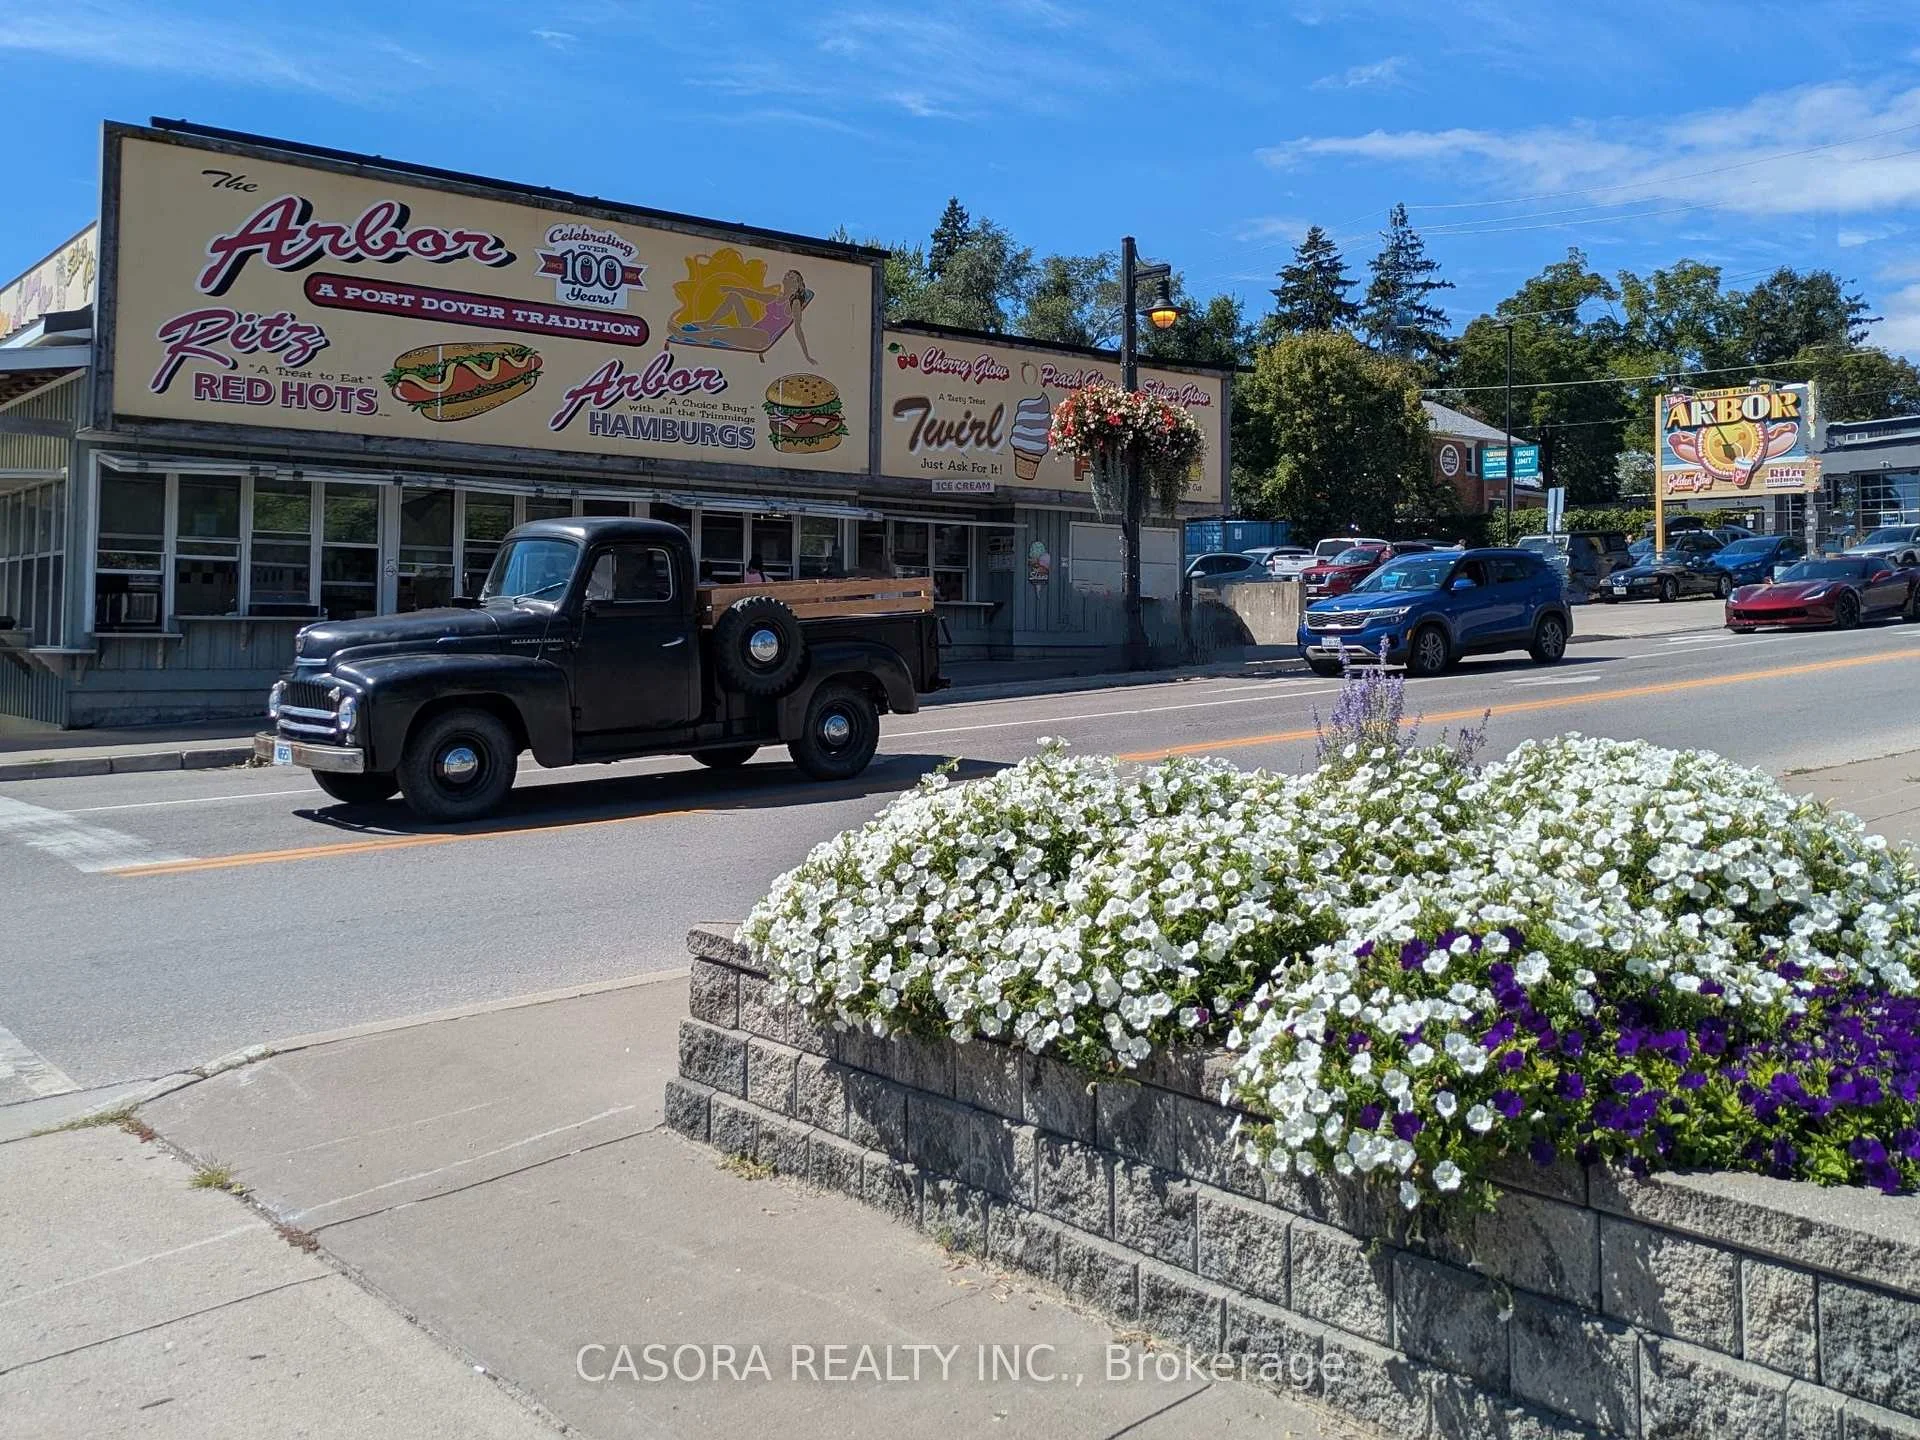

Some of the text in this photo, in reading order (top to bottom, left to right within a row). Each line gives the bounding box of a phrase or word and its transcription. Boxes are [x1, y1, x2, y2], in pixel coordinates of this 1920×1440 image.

[201, 169, 260, 193] The
[195, 193, 517, 297] Arbor
[549, 227, 635, 258] Celebrating
[577, 243, 609, 254] OVER
[560, 248, 623, 291] 100
[315, 283, 641, 337] A PORT DOVER TRADITION
[566, 287, 618, 305] Years!
[149, 306, 331, 394] Ritz
[919, 345, 1010, 385] Cherry Glow
[275, 366, 313, 379] Treat
[319, 372, 335, 382] to
[1039, 362, 1083, 389] Peach
[193, 371, 379, 416] RED HOTS
[550, 350, 728, 431] Arbor
[681, 398, 718, 410] Choice
[1143, 377, 1212, 408] Silver Glow
[1700, 386, 1765, 399] WORLD FAMOUS
[629, 404, 756, 425] with all the Trimmings
[1666, 392, 1800, 428] ARBOR
[588, 411, 756, 449] HAMBURGS
[893, 396, 1005, 456] Twirl
[920, 457, 1003, 475] Just Ask For It!
[1515, 457, 1532, 465] LIMIT
[935, 481, 991, 492] ICE CREAM
